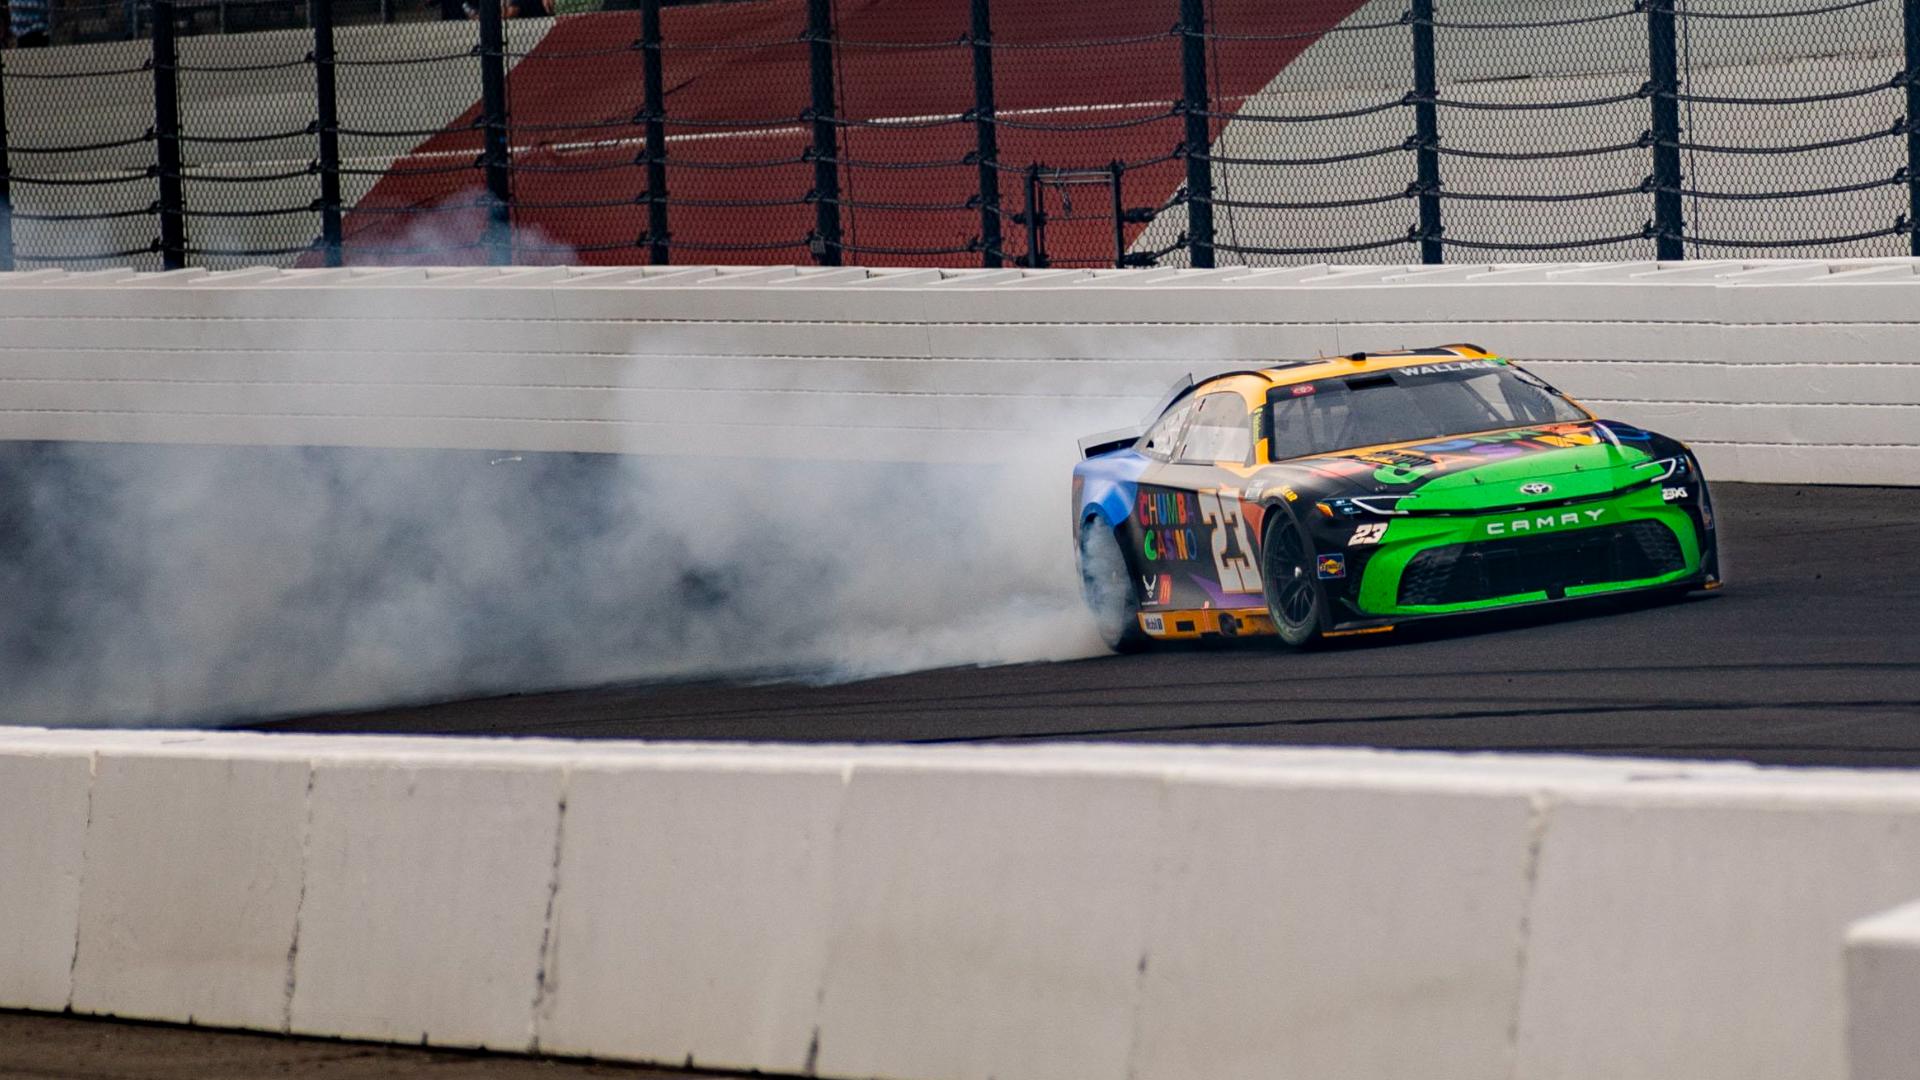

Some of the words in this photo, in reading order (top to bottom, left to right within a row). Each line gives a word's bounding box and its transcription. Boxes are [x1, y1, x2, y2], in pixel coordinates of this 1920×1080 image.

[1138, 490, 1197, 527] CHUMBA
[1486, 507, 1605, 535] CAMRY
[1143, 527, 1199, 561] CASINO
[1198, 487, 1264, 594] 23
[1347, 522, 1389, 546] 23
